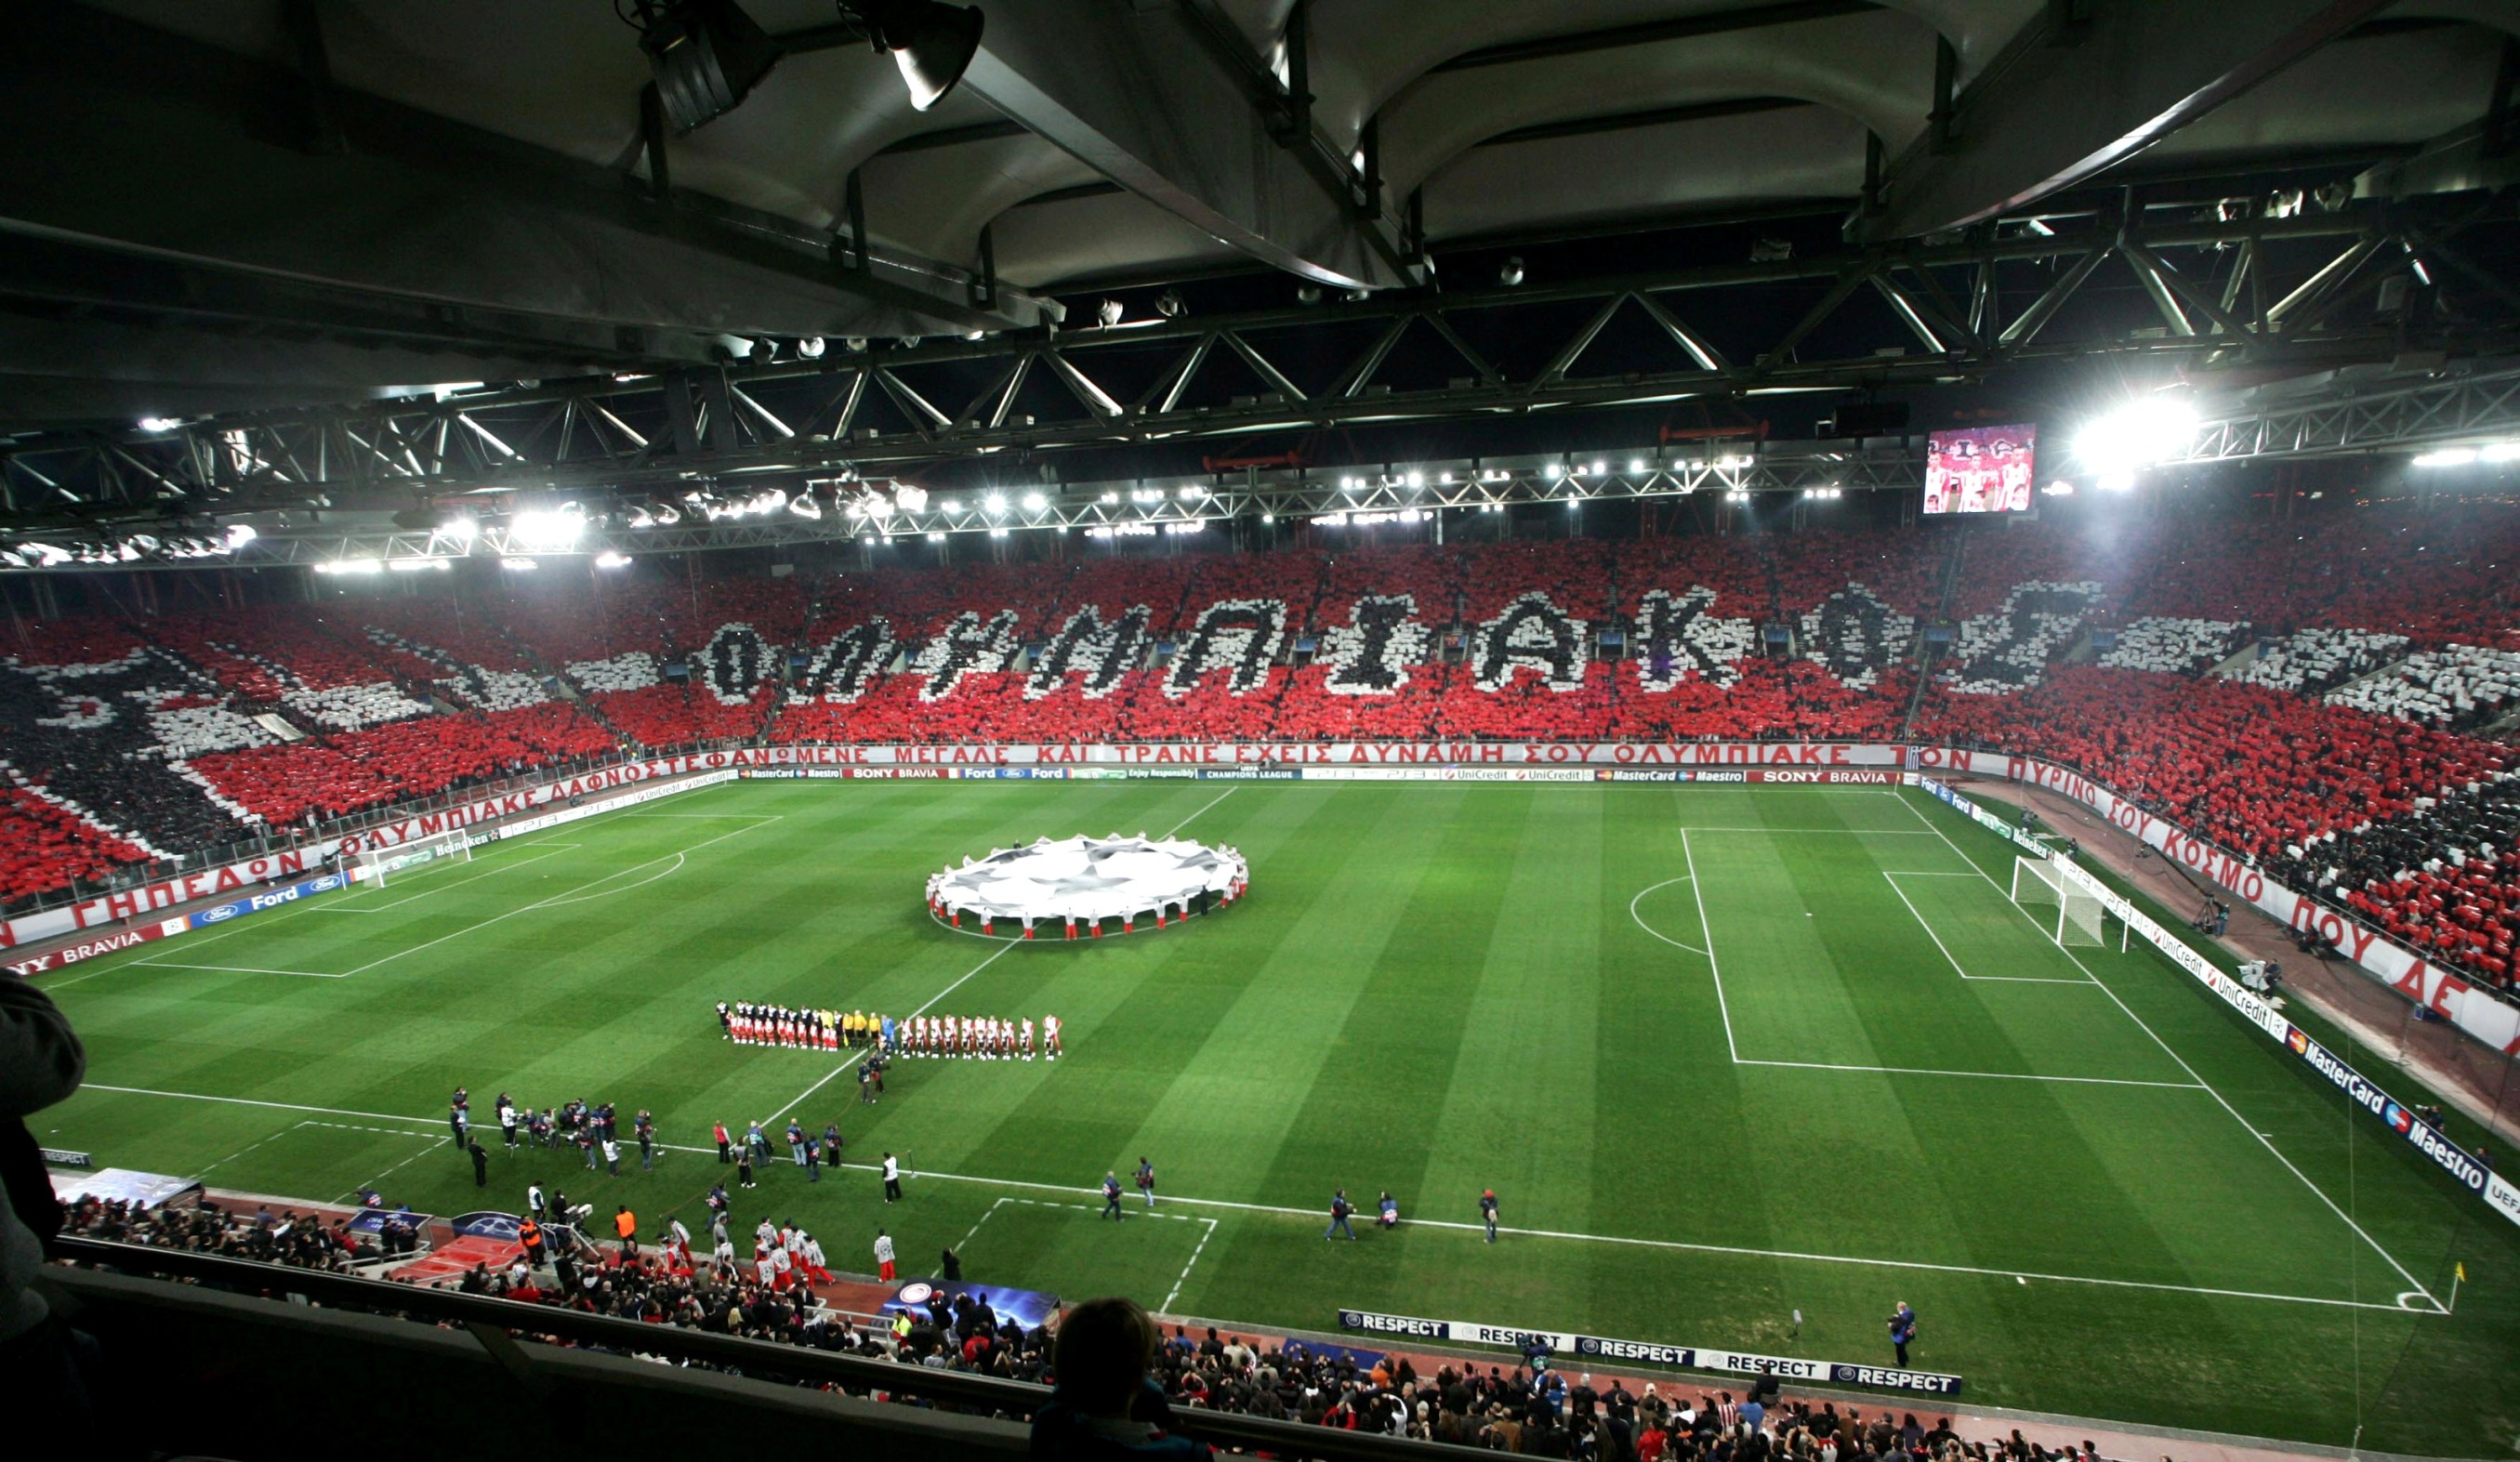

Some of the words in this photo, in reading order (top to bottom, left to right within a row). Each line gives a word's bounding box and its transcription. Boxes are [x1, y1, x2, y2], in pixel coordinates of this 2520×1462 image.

[750, 769, 795, 778] MasterCard
[808, 769, 839, 778] Maestro
[853, 769, 894, 779] SONY
[898, 769, 939, 779] BRAVIA
[965, 768, 996, 779] Ford
[1031, 768, 1063, 779] Ford
[1128, 769, 1150, 779] Enjoy
[1207, 771, 1256, 779] CHAMPIONS
[1259, 771, 1293, 779] LEAGUE
[1458, 769, 1508, 780] UniCredit
[1528, 770, 1581, 781] UniCredit
[1613, 771, 1676, 782] MasterCard
[1696, 771, 1743, 782] Maestro
[1763, 771, 1824, 783] SONY
[1830, 772, 1887, 784] BRAVIA
[1921, 776, 1937, 794] Ford
[1952, 794, 1970, 814] Ford
[2013, 827, 2048, 860] Heineken
[894, 746, 1009, 764] ΜΕΓΑΛΕ
[1037, 746, 1087, 763] ΚΑΙ
[1115, 745, 1218, 763] ΤΡΑΝΕ
[1235, 744, 1333, 763] ΕΧΕΙΣ
[1348, 744, 1504, 763] ΔΥΝΑΜΗ
[1524, 744, 1597, 763] ΣΟΥ
[1614, 744, 1851, 765] ΟΛΥΜΠΙΑΚΕ
[2008, 757, 2096, 807] ΠΥΡΙΝΟ
[2108, 797, 2153, 838] ΣΟΥ
[2163, 828, 2263, 902] ΚΟΣΜΟ
[2291, 896, 2375, 964] ΠΟΥ
[2394, 961, 2472, 1020] ΔΕ
[251, 885, 298, 911] Ford
[62, 931, 142, 964] BRAVIA
[2161, 933, 2203, 977] UniCredit
[2218, 976, 2268, 1027] UniCredit
[2304, 1042, 2385, 1114] MasterCard
[2408, 1121, 2484, 1190] Maestro
[1363, 1315, 1442, 1337] RESPECT
[1601, 1341, 1688, 1364] RESPECT
[1727, 1355, 1817, 1376] RESPECT
[1857, 1368, 1952, 1392] RESPECT
